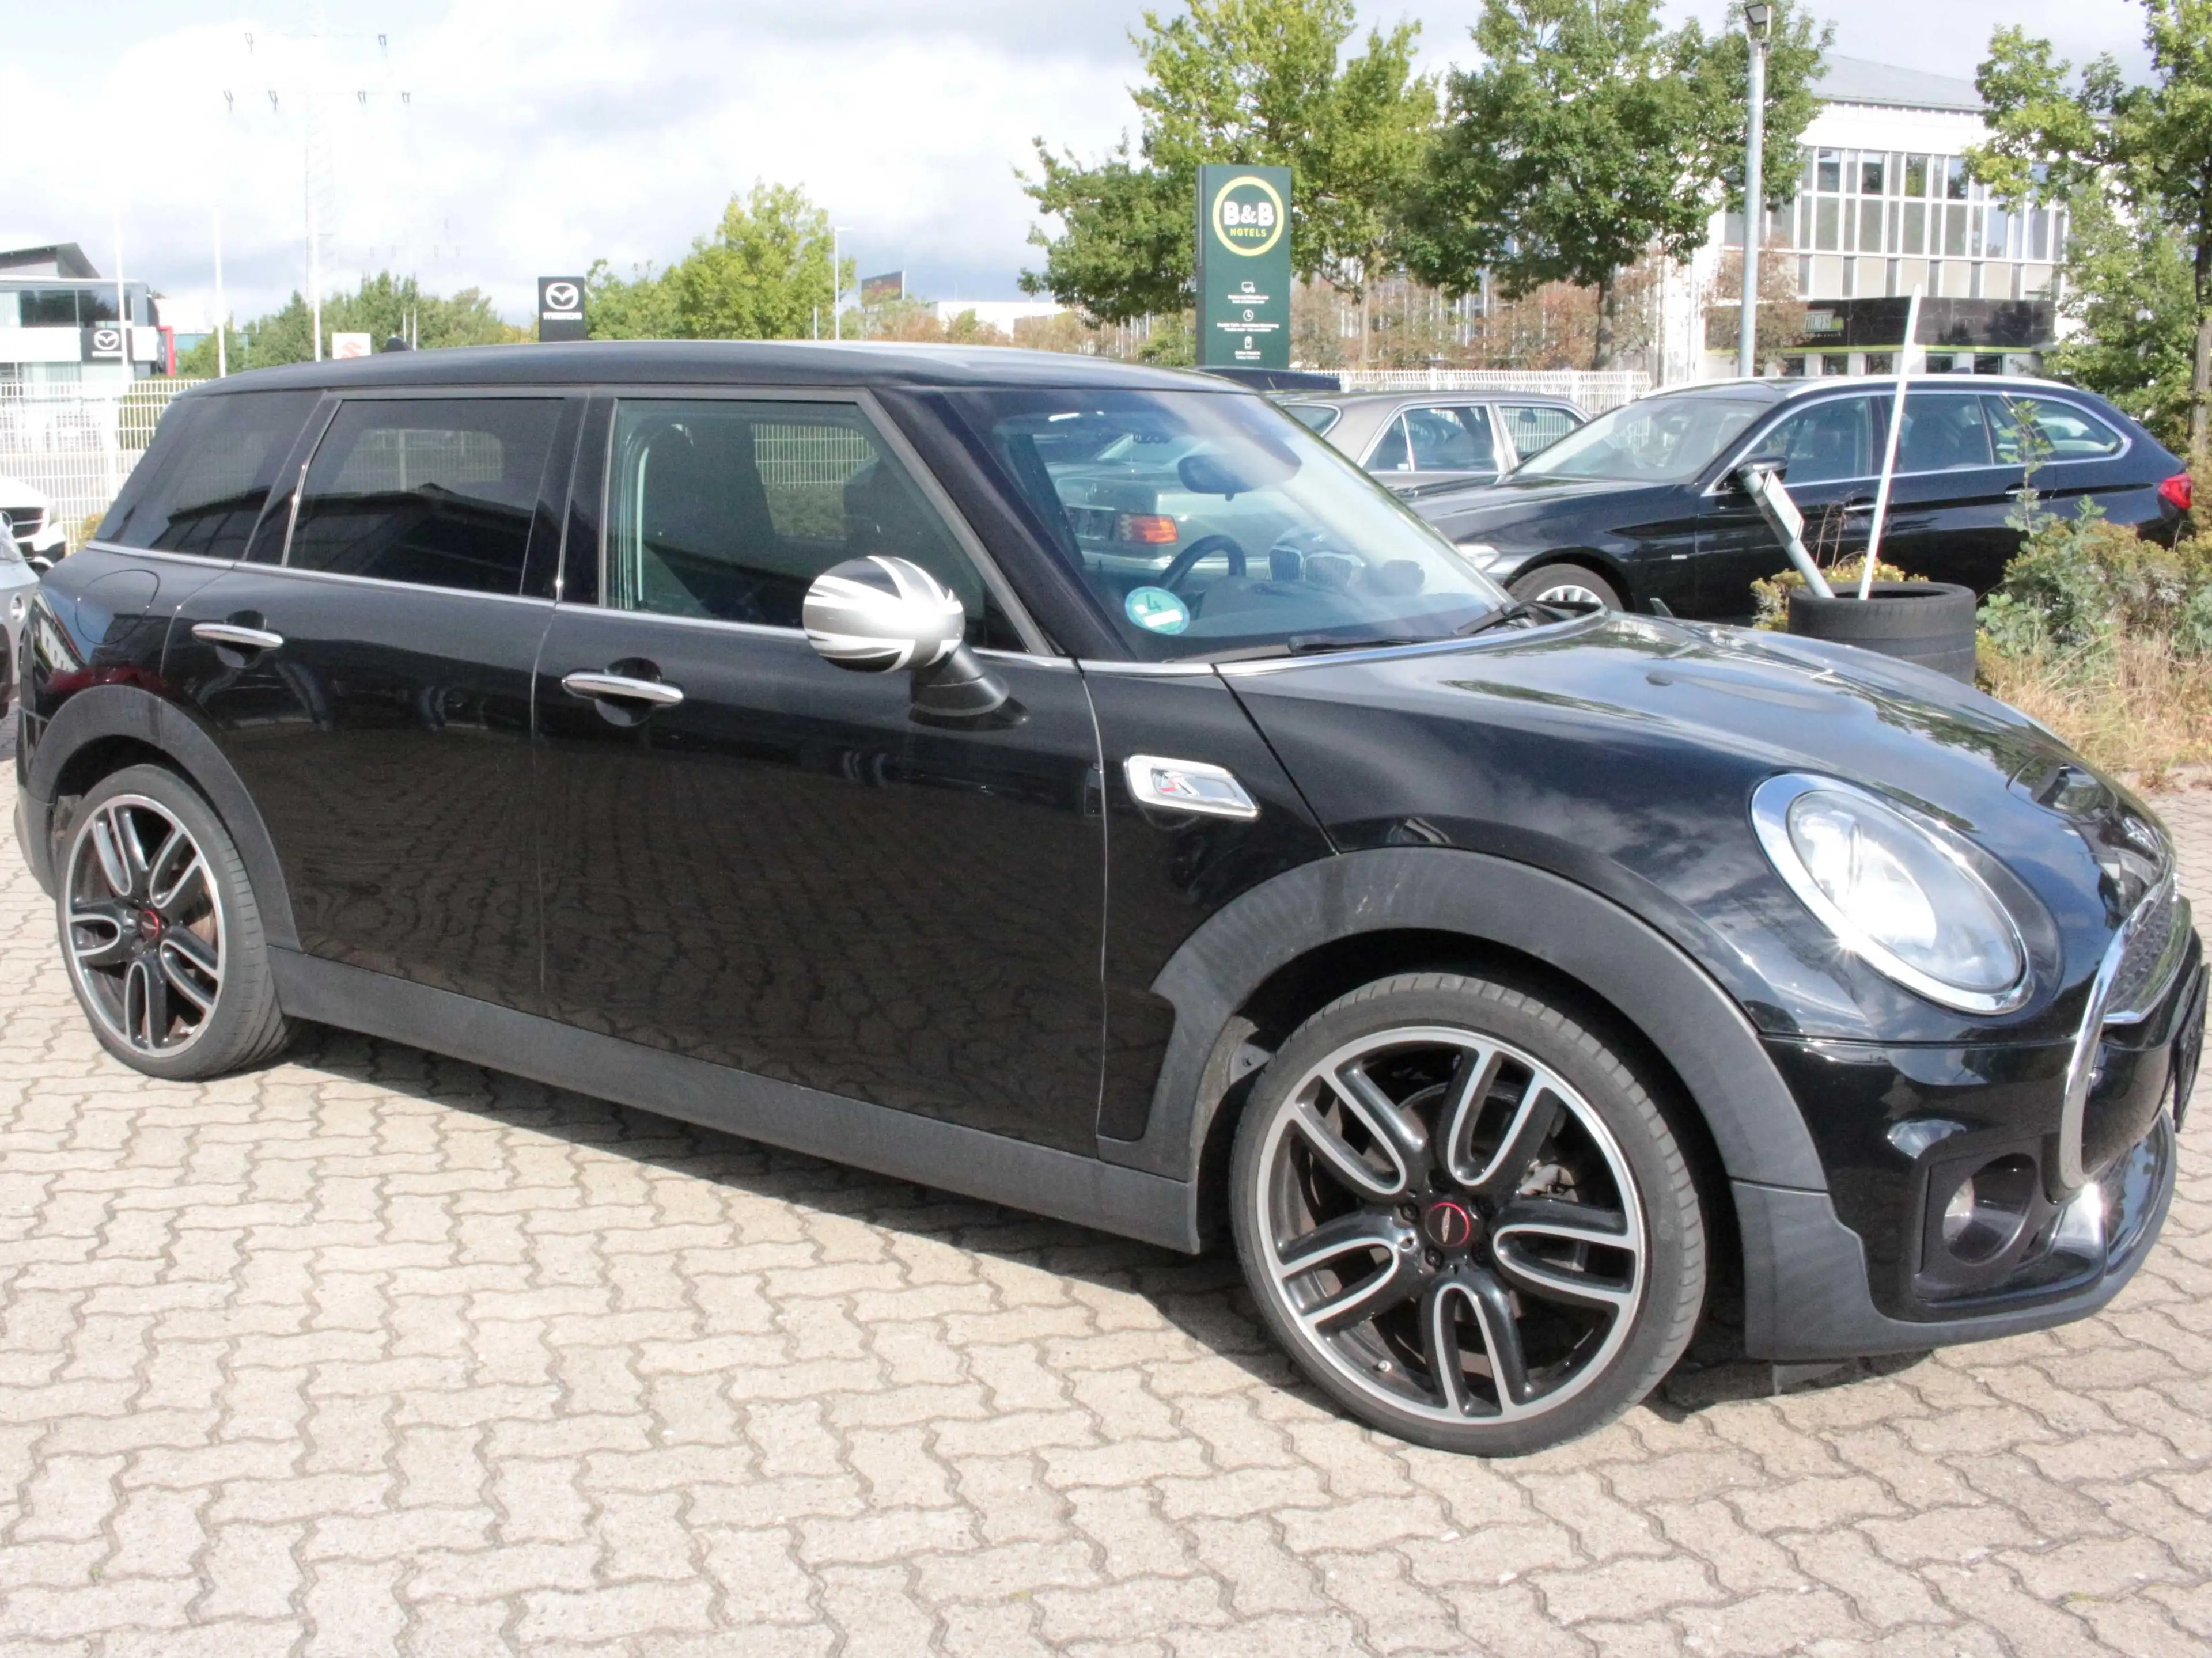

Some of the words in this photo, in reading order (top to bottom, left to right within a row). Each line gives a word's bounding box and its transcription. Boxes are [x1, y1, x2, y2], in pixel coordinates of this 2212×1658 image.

[1224, 201, 1274, 226] B&B
[1230, 227, 1267, 237] HOTELS
[1145, 593, 1162, 611] 4
